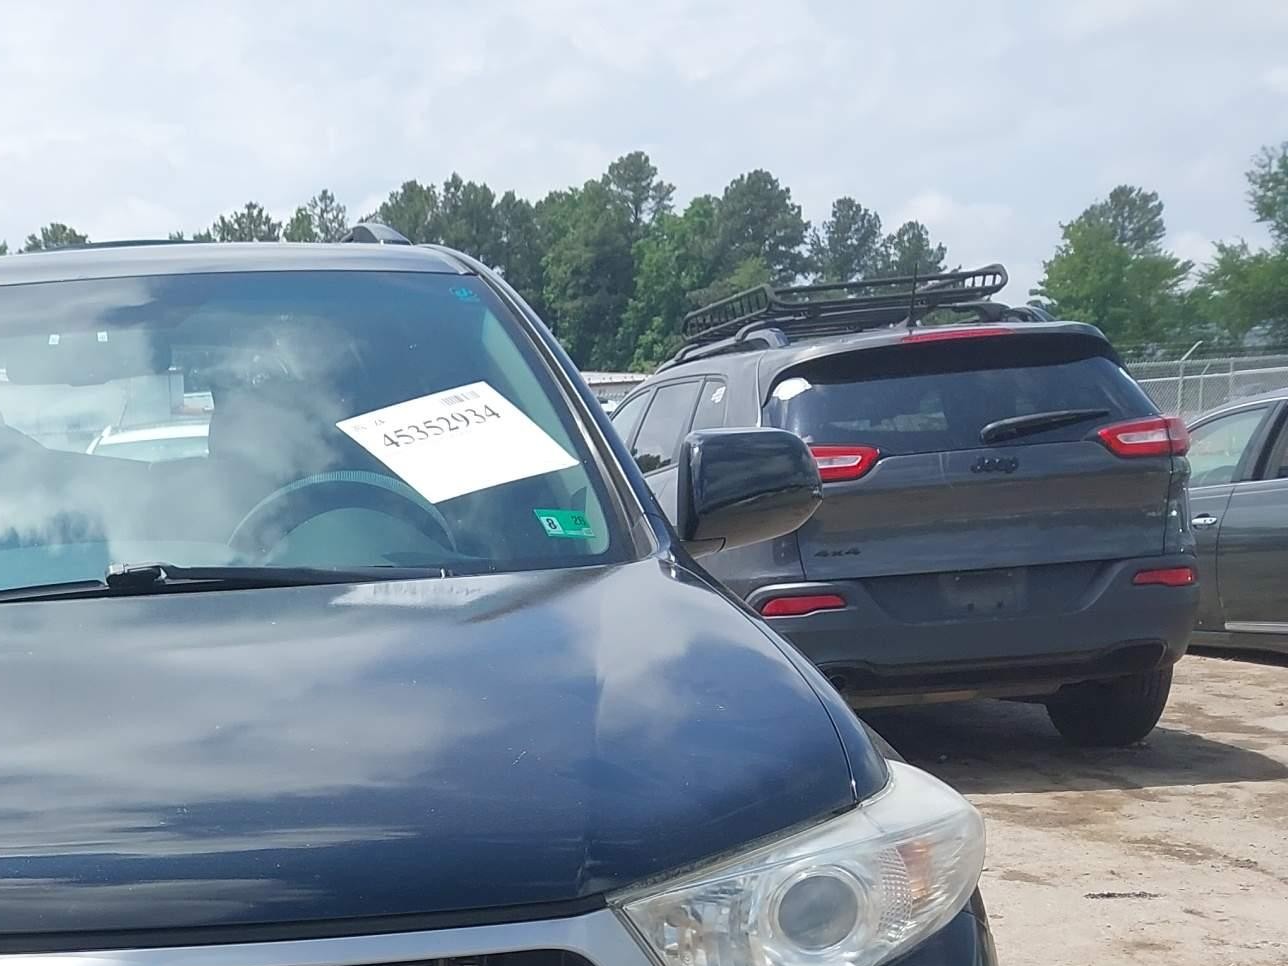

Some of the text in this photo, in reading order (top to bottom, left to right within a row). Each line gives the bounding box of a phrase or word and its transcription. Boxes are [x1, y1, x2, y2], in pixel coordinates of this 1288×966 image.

[383, 404, 501, 448] 45352934
[970, 455, 1019, 474] Jeep
[545, 518, 558, 530] 8
